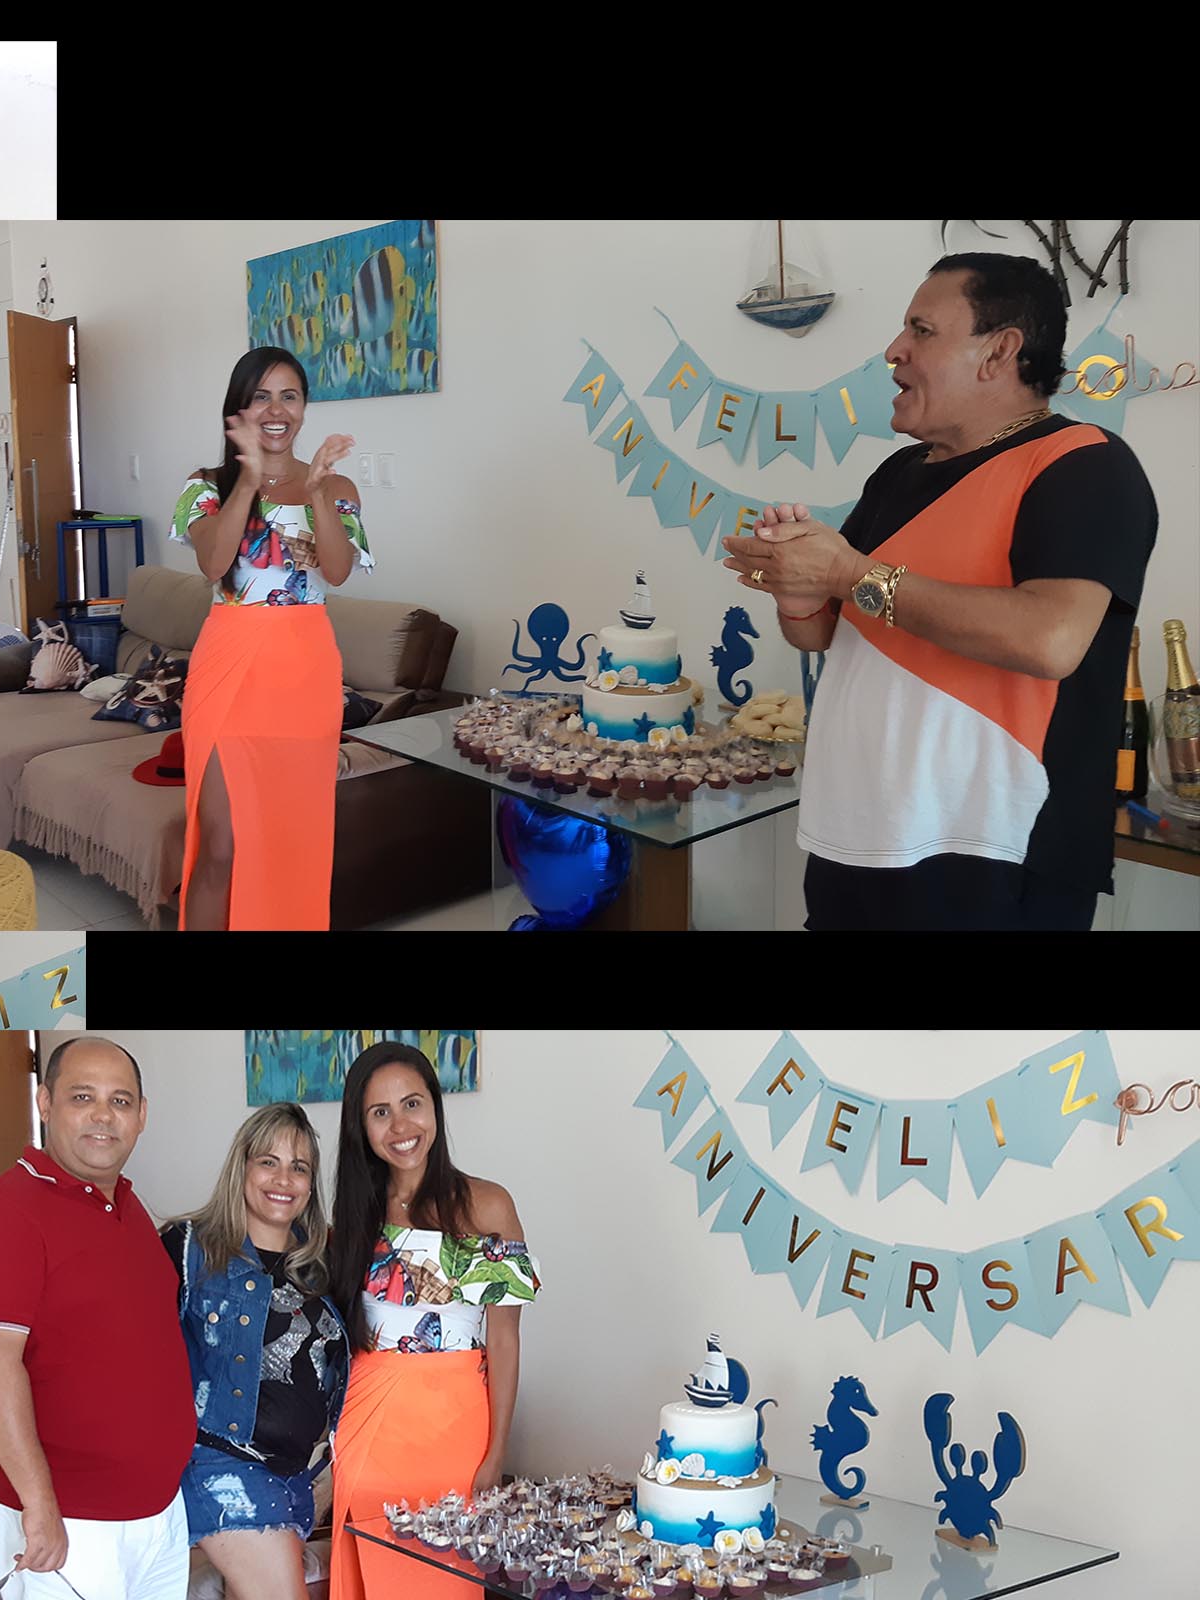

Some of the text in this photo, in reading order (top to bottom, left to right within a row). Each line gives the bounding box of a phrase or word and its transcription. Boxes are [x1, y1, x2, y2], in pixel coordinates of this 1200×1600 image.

[667, 361, 898, 442] FELI
[765, 1050, 1099, 1167] FELIZ
[656, 1070, 1185, 1313] ANIVERSAR
